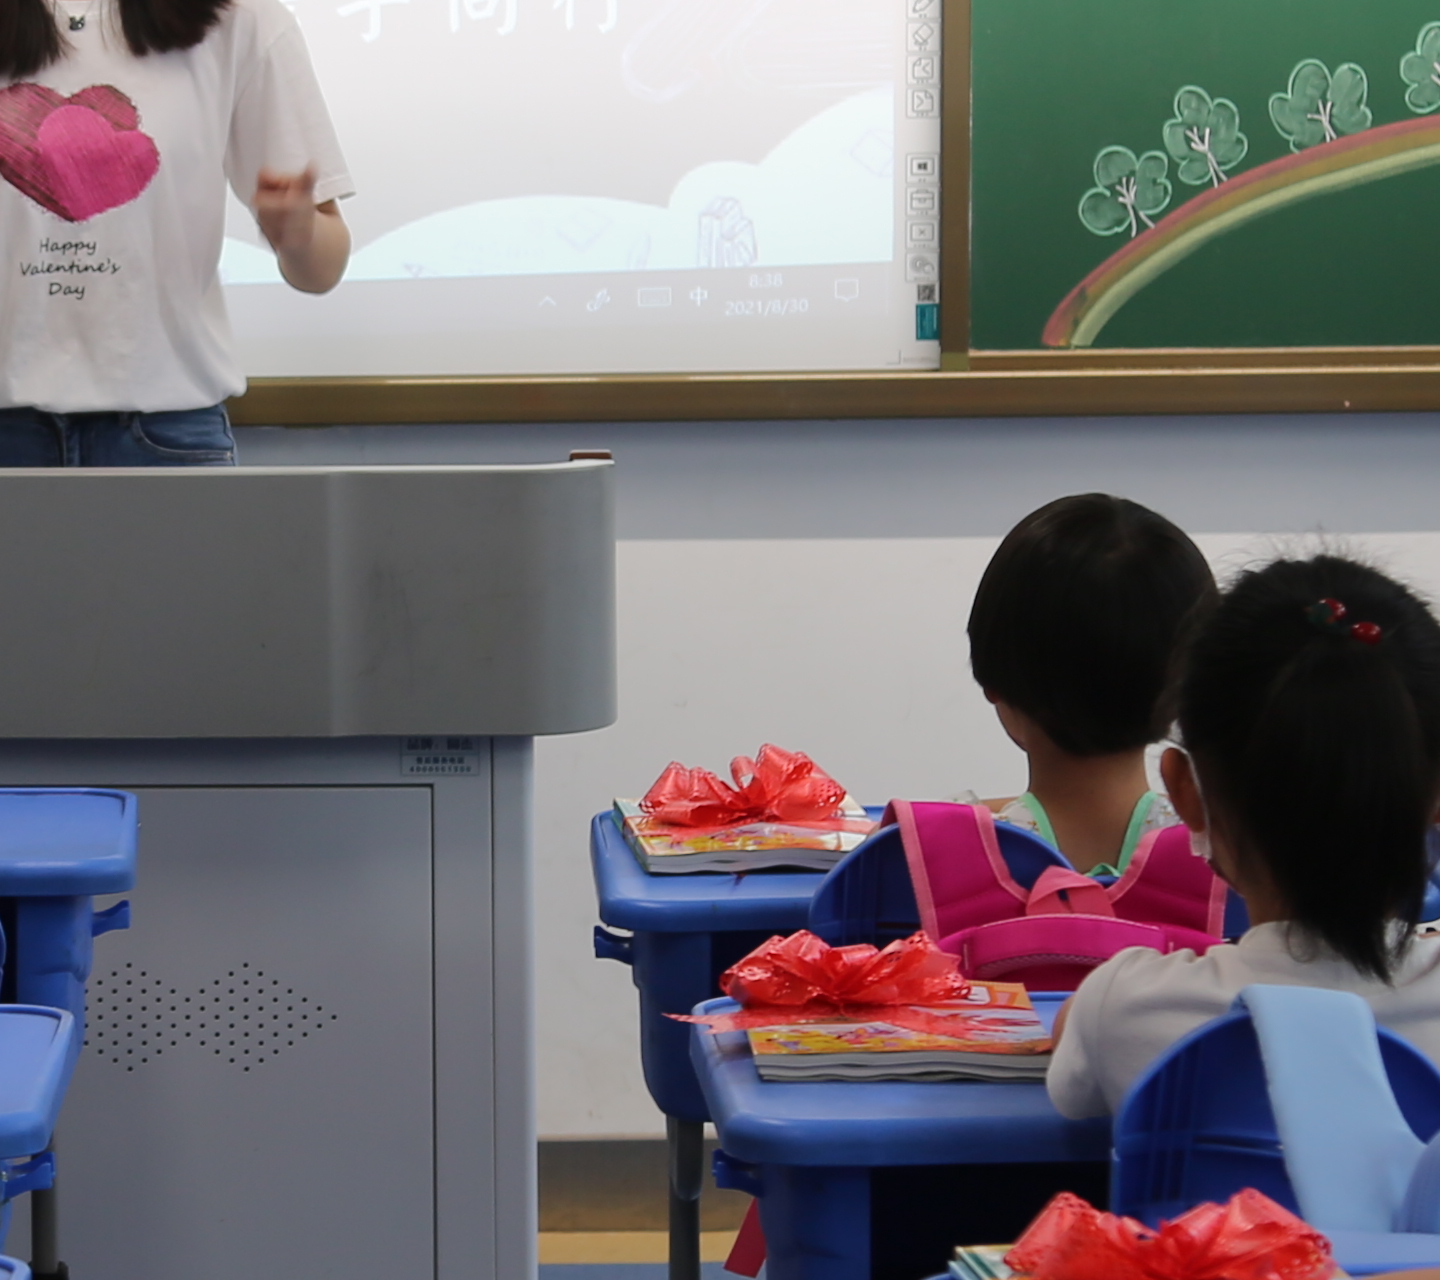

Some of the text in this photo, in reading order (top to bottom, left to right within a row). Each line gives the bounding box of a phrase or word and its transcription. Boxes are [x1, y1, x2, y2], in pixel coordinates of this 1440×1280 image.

[39, 236, 97, 255] Happy
[20, 258, 120, 276] Valentine's
[749, 273, 784, 289] 8:38
[49, 282, 85, 300] Day
[724, 298, 810, 317] 2021/8/30
